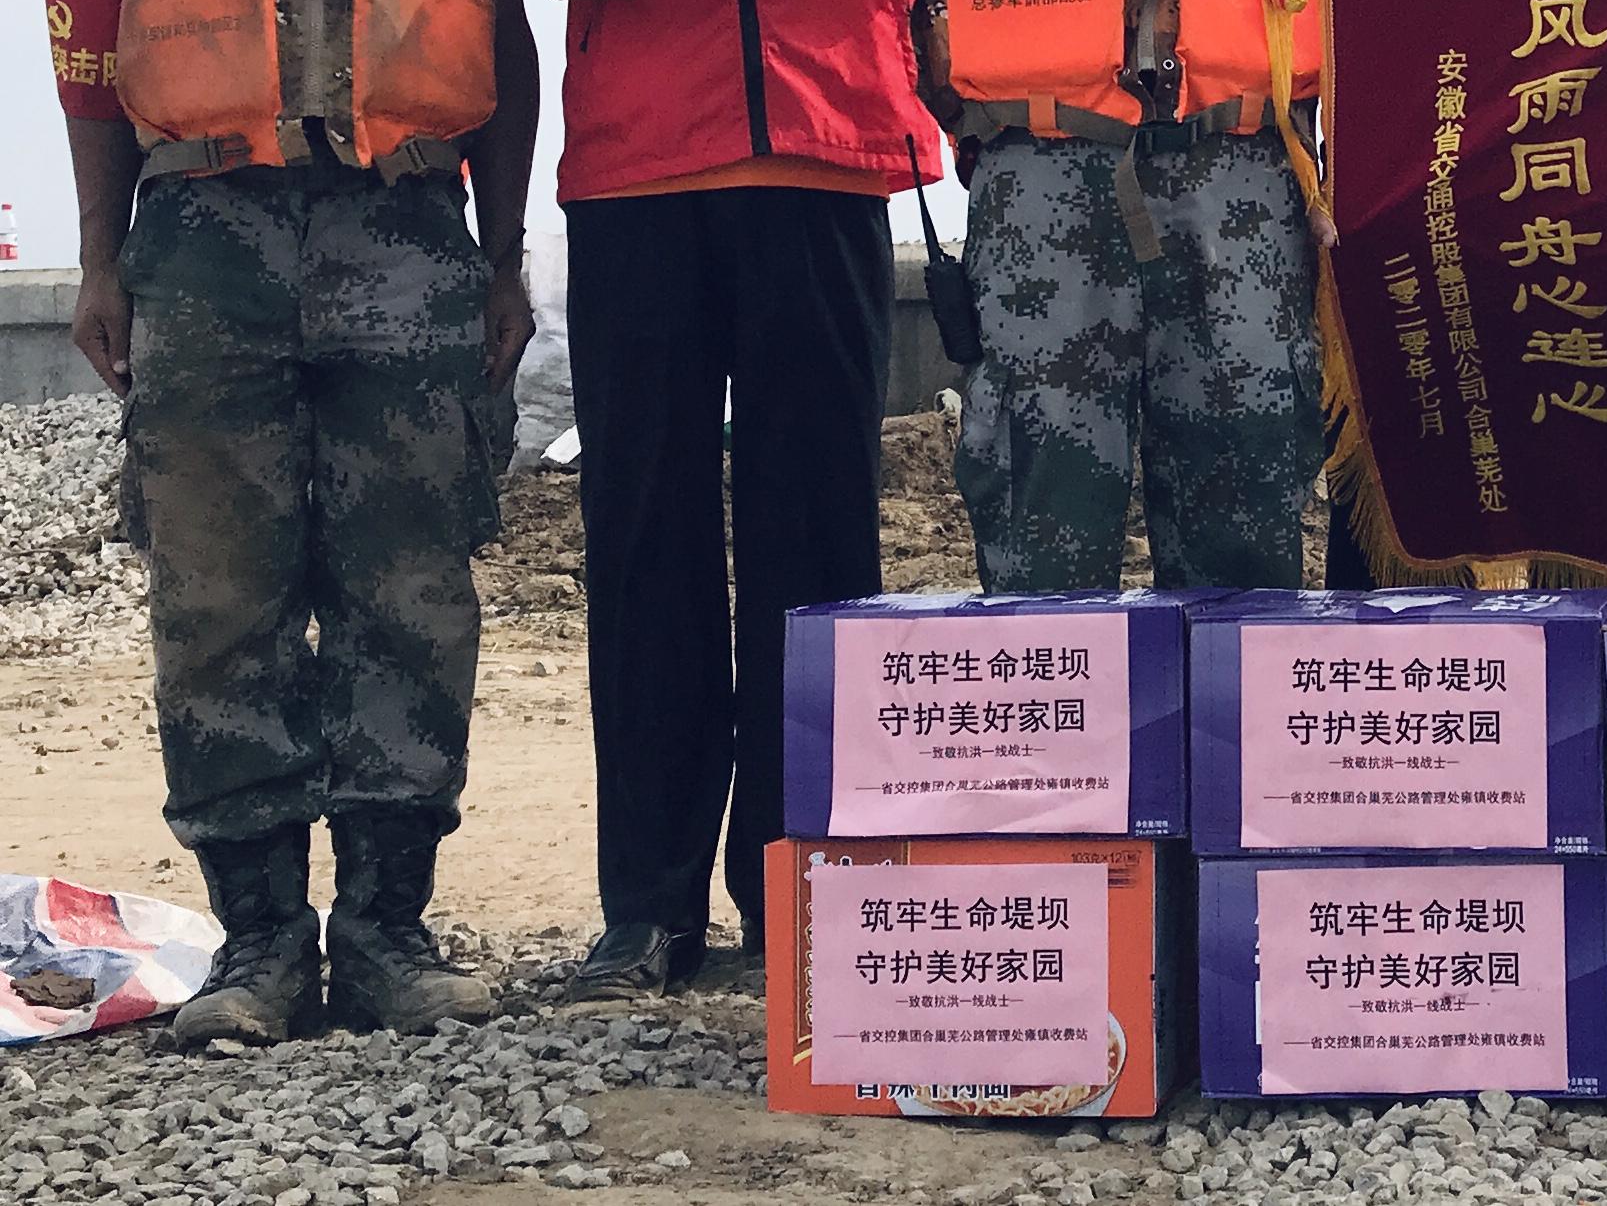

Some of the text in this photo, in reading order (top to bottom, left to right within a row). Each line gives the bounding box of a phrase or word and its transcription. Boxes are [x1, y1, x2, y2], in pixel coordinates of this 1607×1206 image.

[1384, 253, 1444, 439] 二零二零年七月
[882, 647, 1091, 685] 筑牢生命堤坝
[1291, 657, 1507, 693] 筑牢生命堤坝
[878, 699, 1085, 736] 守护美好家园
[1286, 710, 1501, 745] 守护美好家园
[860, 896, 1070, 932] 筑牢生命堤坝
[1309, 899, 1526, 937] 筑牢生命堤坝
[855, 948, 1064, 984] 守护美好家园
[1306, 951, 1520, 990] 守护美好家园
